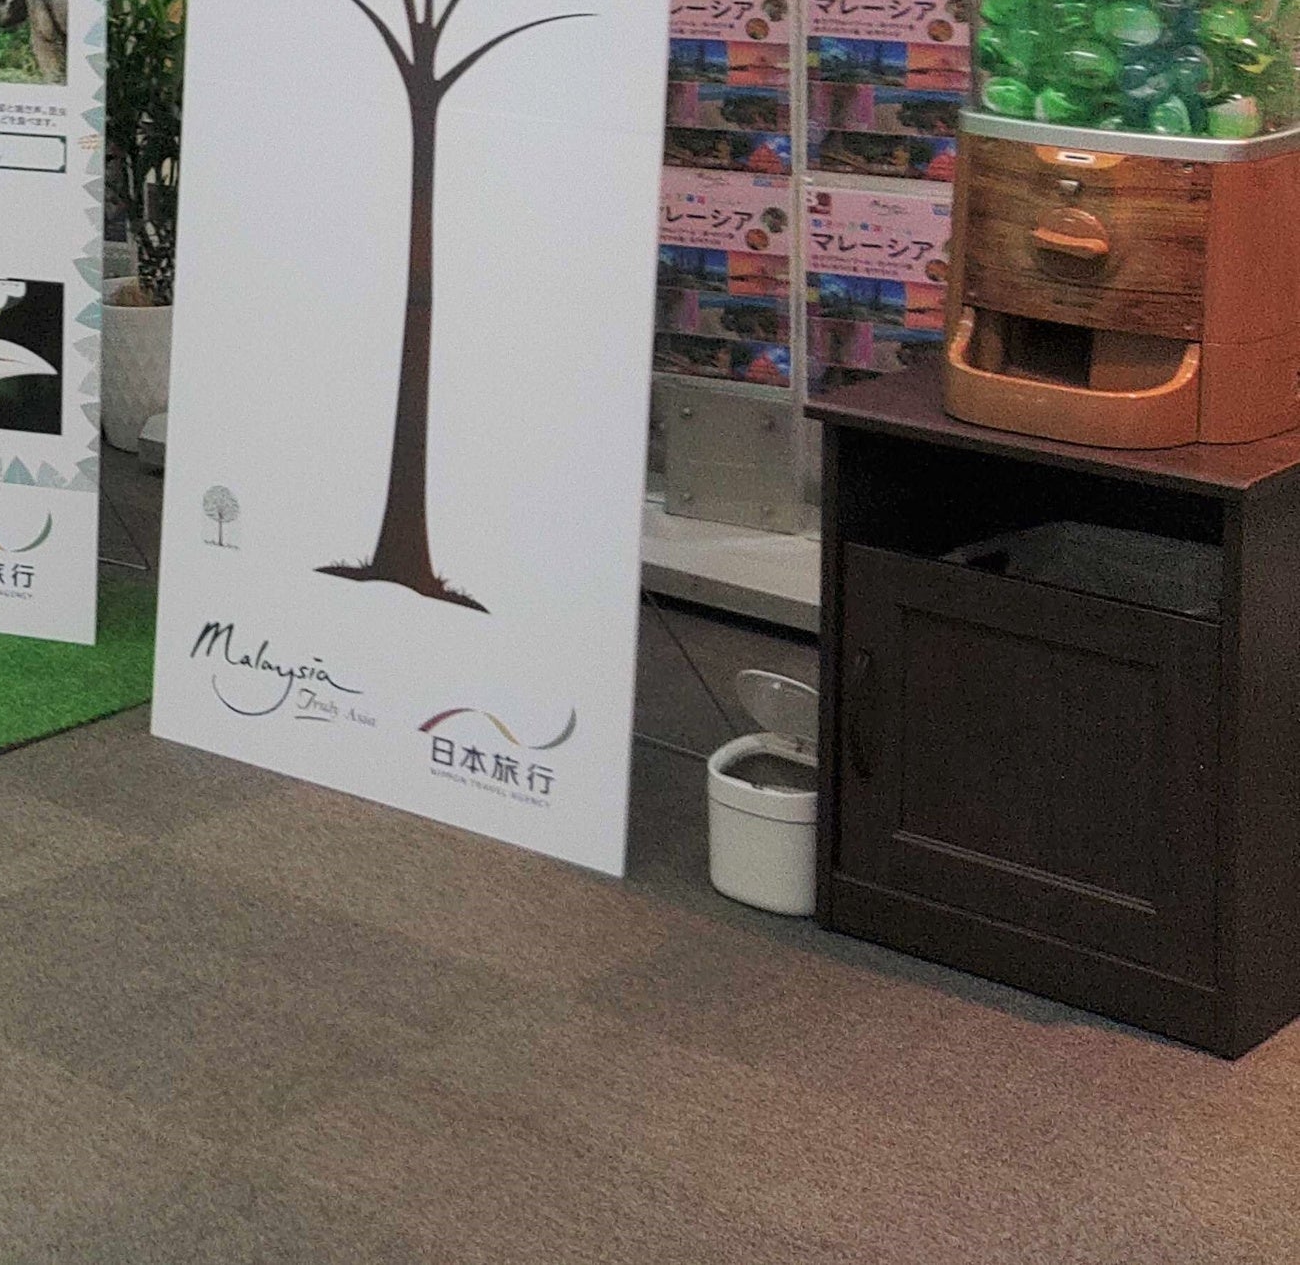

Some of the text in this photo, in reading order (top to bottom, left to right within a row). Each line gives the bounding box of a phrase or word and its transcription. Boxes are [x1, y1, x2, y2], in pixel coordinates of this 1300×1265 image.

[660, 207, 754, 231] レーシア
[811, 233, 934, 261] マレーシア
[190, 620, 363, 717] Malaysia
[431, 735, 555, 795] 日本旅行
